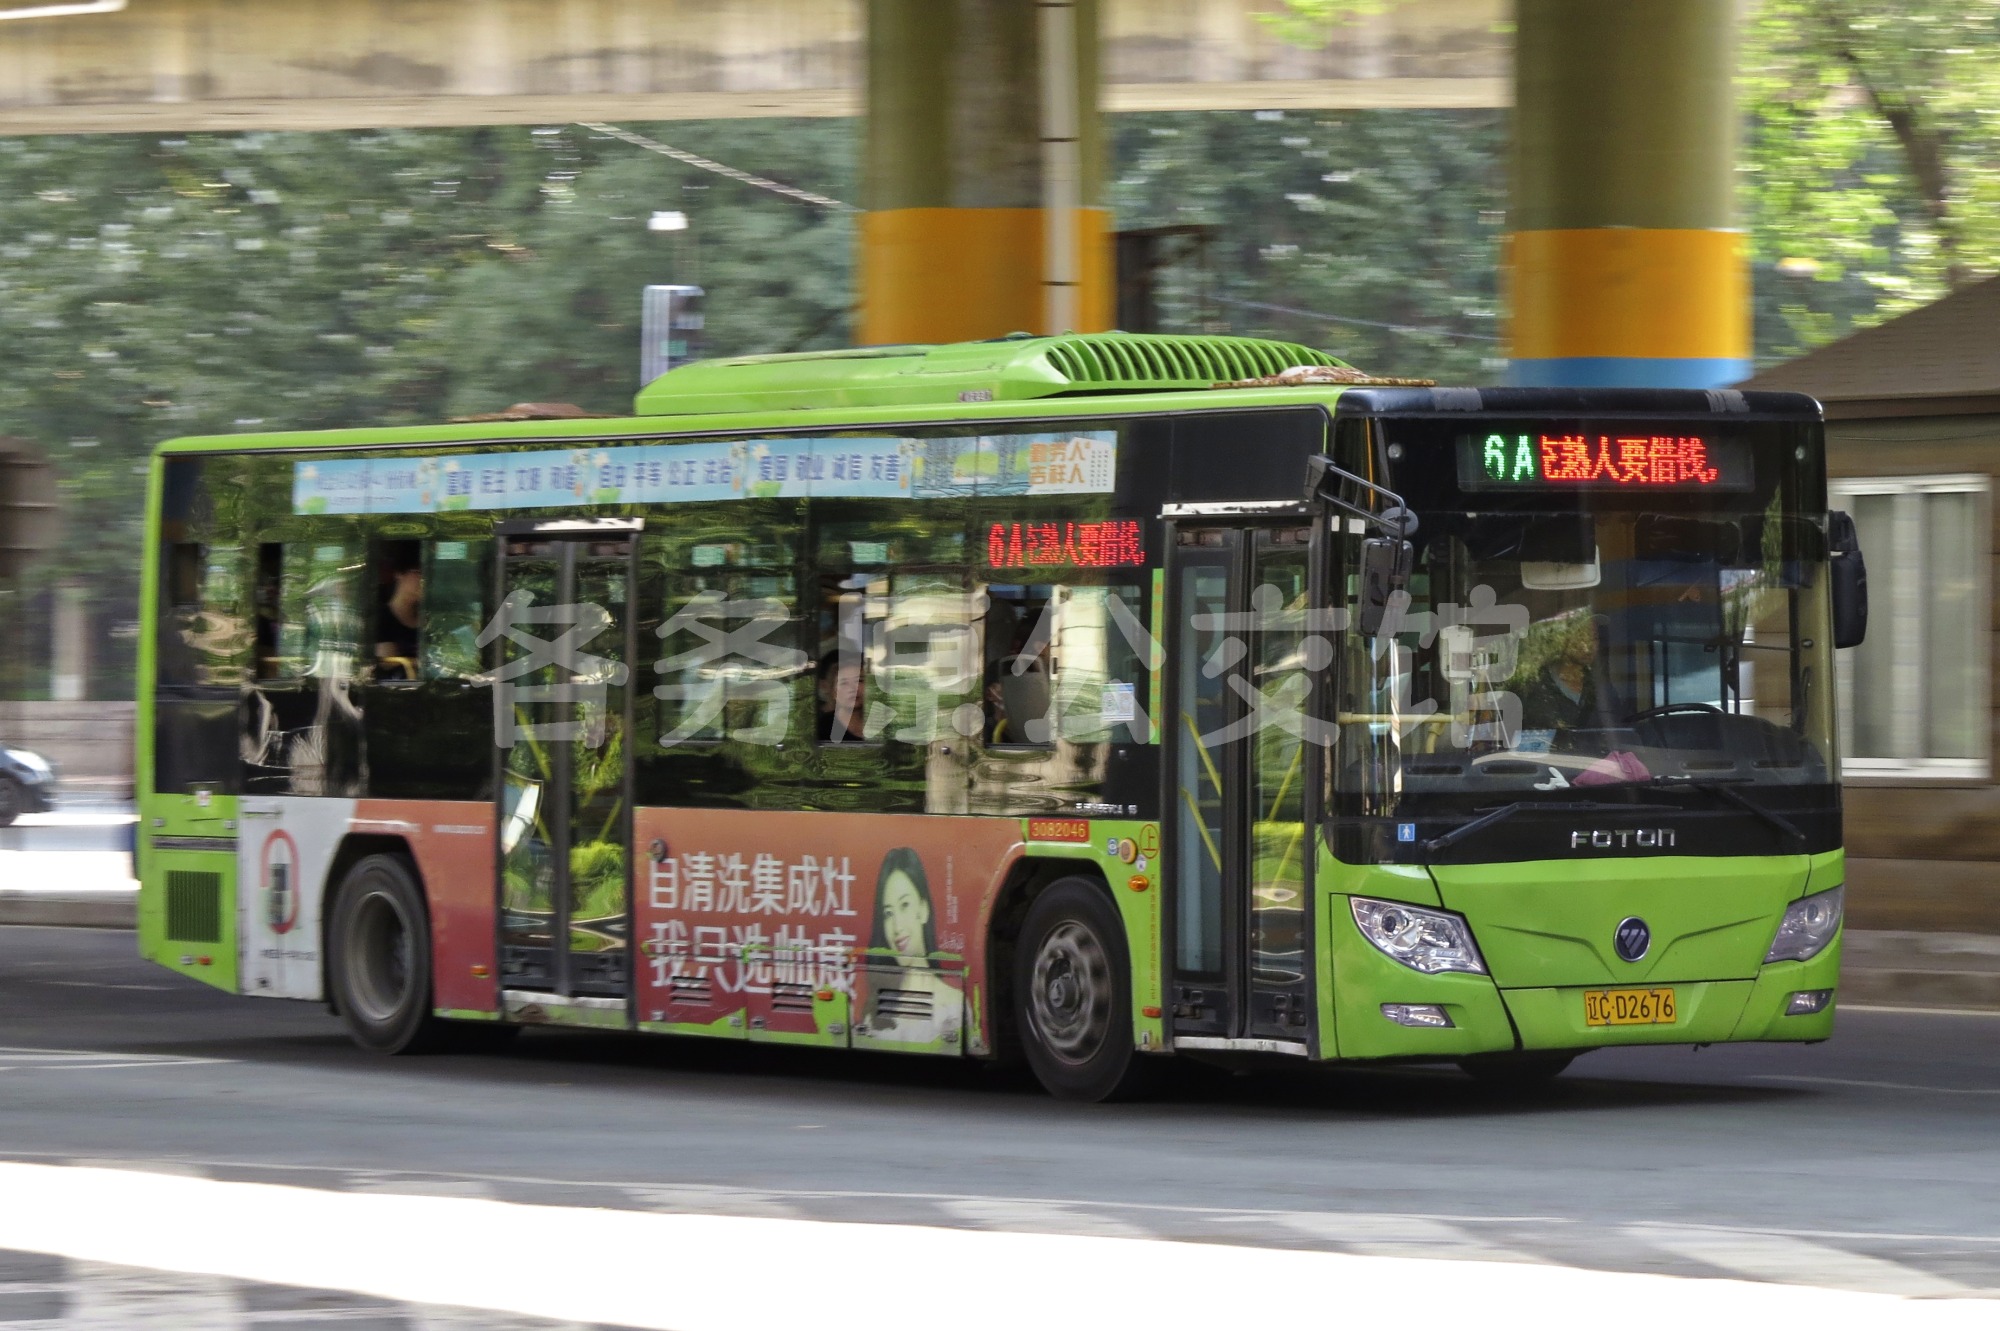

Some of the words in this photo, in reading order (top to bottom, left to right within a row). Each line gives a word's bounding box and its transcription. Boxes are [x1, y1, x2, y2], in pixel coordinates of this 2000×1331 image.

[1483, 433, 1535, 482] 6A
[988, 522, 1025, 568] 6A
[1031, 822, 1086, 838] 3082046
[1571, 828, 1676, 849] FOTON
[649, 850, 858, 917] 自清洗集成灶
[650, 919, 858, 1000] 我只选帅康
